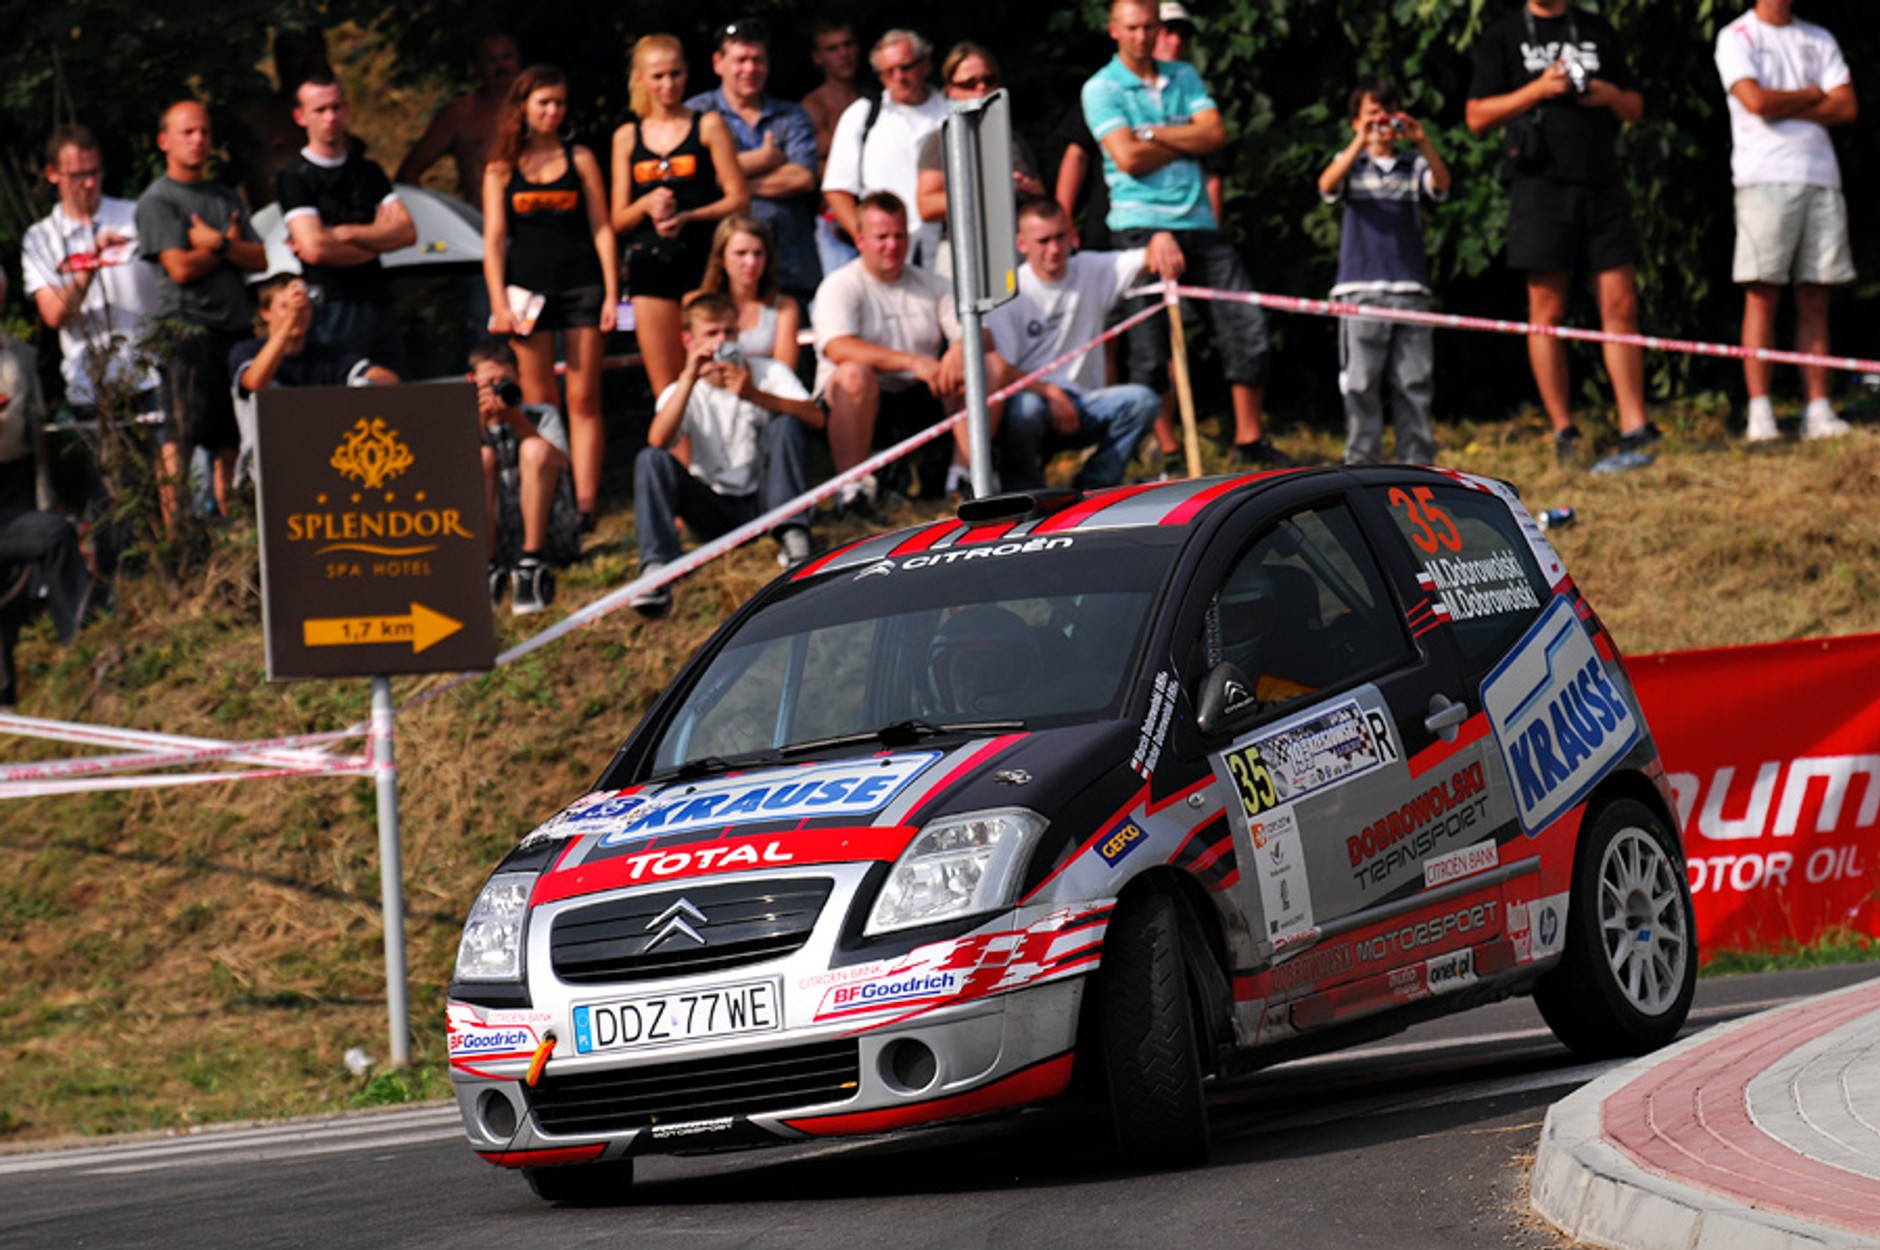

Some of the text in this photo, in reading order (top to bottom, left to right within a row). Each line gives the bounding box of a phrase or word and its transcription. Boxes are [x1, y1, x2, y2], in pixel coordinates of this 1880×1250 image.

[286, 509, 477, 541] SPLENDOR
[1388, 486, 1463, 553] 35
[325, 561, 431, 579] SPA HOTEL
[341, 621, 415, 641] 1,7 km
[1366, 712, 1397, 762] R
[1509, 656, 1627, 812] KRAUSE
[1229, 747, 1275, 815] 35
[626, 775, 899, 833] KRAUSE
[1346, 760, 1487, 868] DOBROWOLSKI
[626, 841, 793, 879] TOTAL
[1102, 824, 1139, 858] GEFCO
[1354, 796, 1489, 891] TRANSPORT
[1468, 846, 1496, 870] BANK
[1806, 845, 1862, 883] OIL
[1355, 901, 1499, 965] MOTORSPORT
[850, 963, 884, 979] BANK
[1430, 952, 1470, 984] onet.pl
[833, 972, 956, 1004] BFGoodrich
[595, 985, 770, 1047] DDZ 77WE
[450, 1030, 527, 1051] BFGoodrich
